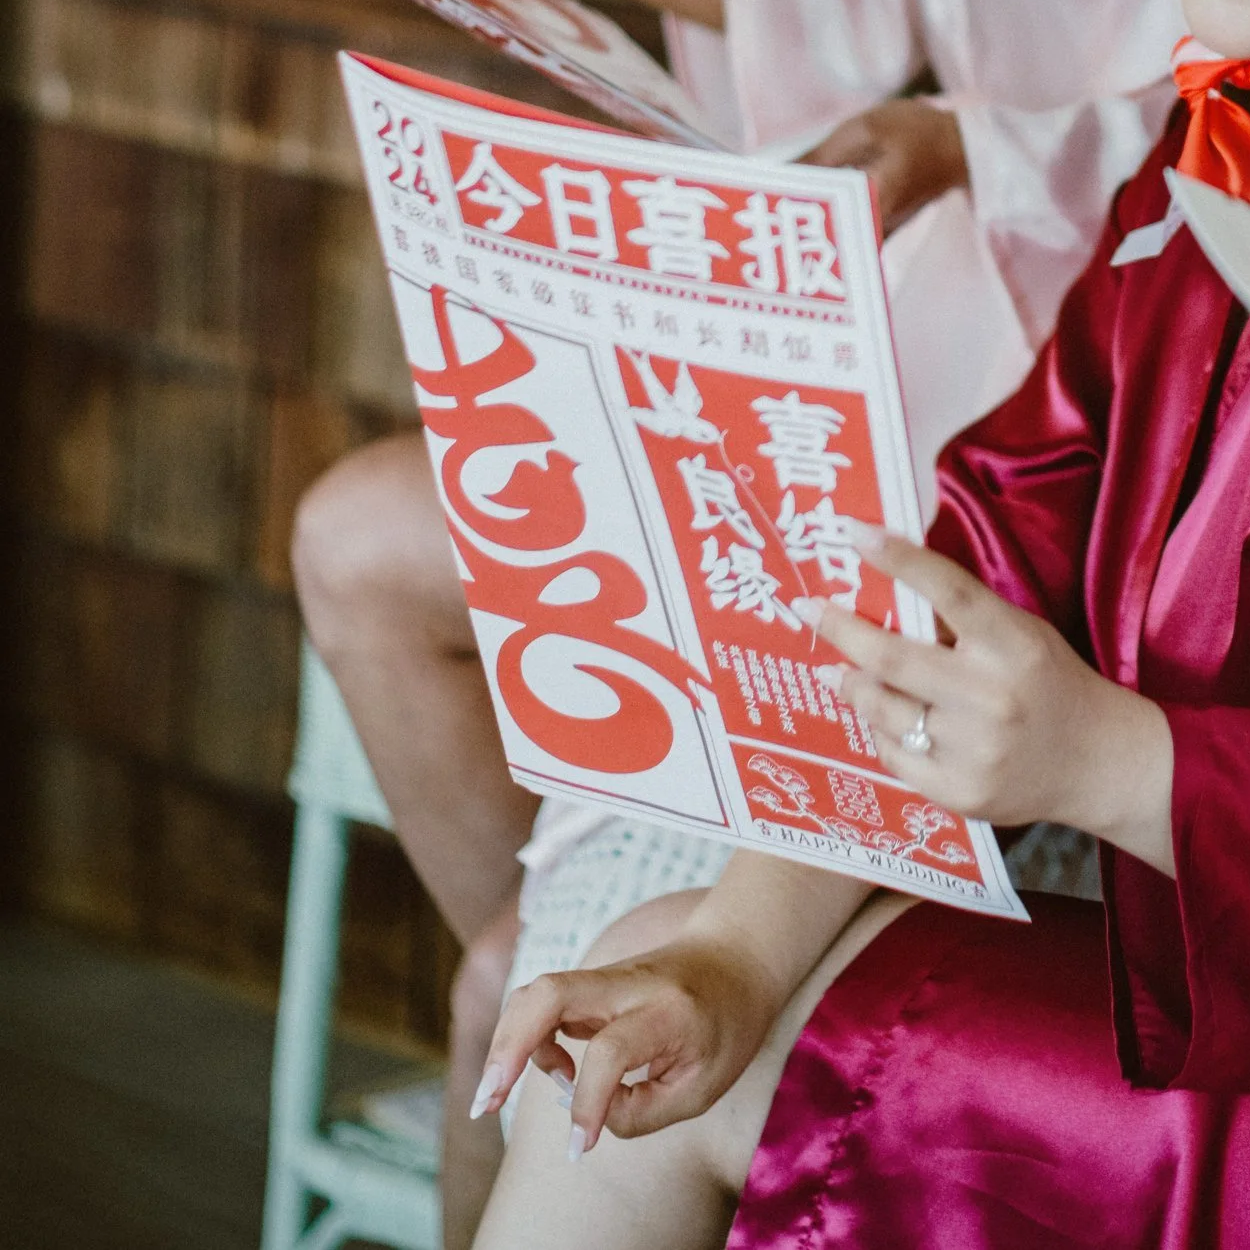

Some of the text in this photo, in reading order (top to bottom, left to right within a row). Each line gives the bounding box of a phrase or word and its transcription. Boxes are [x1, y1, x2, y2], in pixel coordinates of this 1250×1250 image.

[373, 100, 426, 158] 20
[384, 145, 438, 205] 24
[455, 142, 846, 297] 今日喜报
[676, 453, 803, 631] 良缘
[780, 827, 966, 895] HAPPY WEDDING
